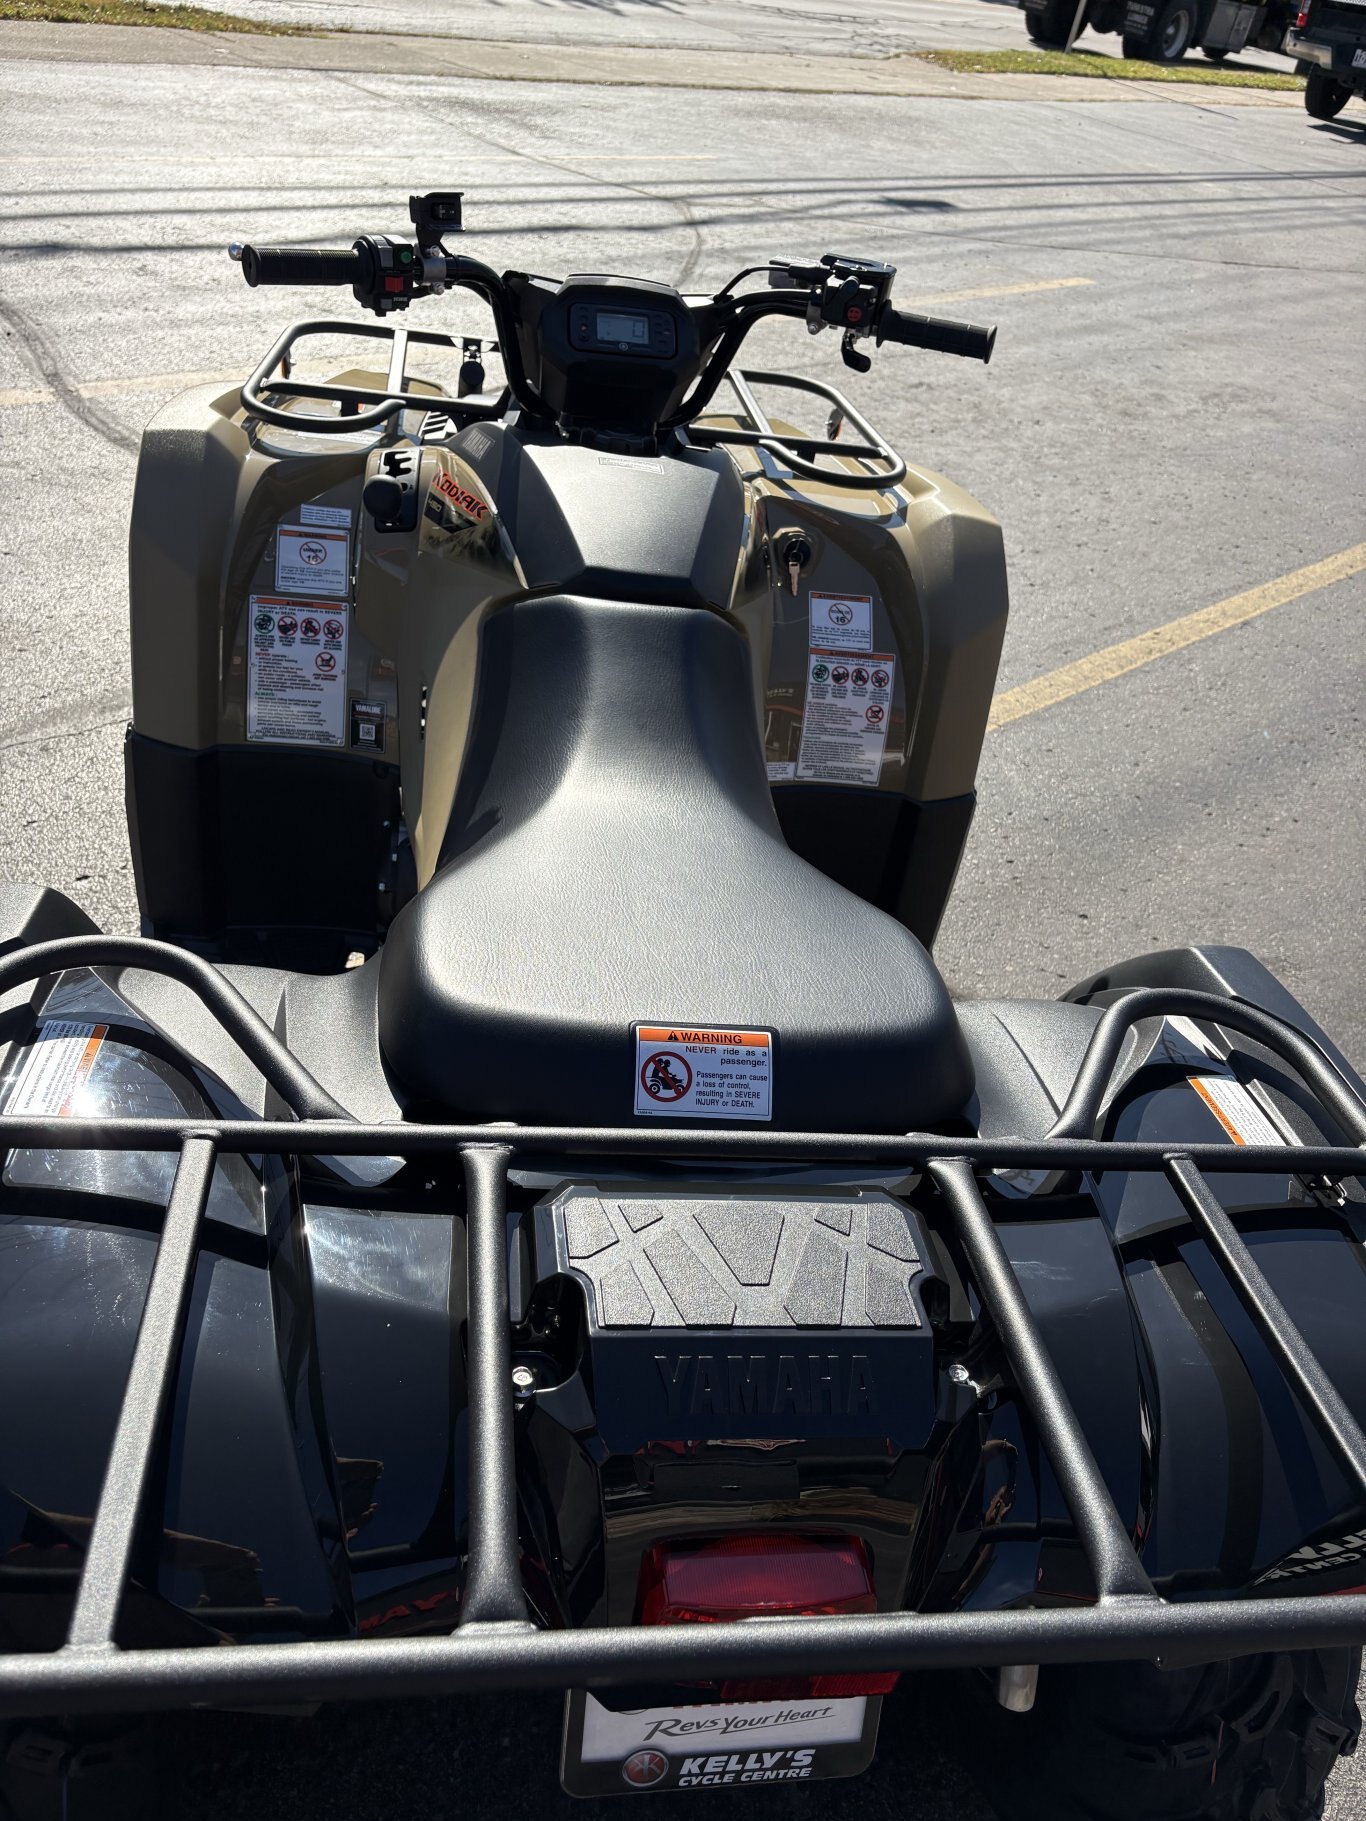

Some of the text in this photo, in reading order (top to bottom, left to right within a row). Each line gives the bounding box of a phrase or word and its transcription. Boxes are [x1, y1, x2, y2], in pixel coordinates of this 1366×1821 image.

[432, 469, 489, 520] KODIAK
[680, 1031, 743, 1044] WARNING
[685, 1045, 717, 1055] NEVER
[722, 1047, 740, 1056] ride
[745, 1049, 756, 1057] as
[720, 1057, 767, 1068] passenger.
[696, 1070, 768, 1082] Passengers can cause
[702, 1080, 716, 1088] loss
[695, 1090, 761, 1099] resulting in SEVERE
[695, 1099, 719, 1107] INJURY
[731, 1100, 755, 1108] DEATH.
[653, 1355, 872, 1416] YAMAHA
[643, 1707, 833, 1742] Revs Your Heart
[679, 1749, 816, 1776] KELLY'S
[678, 1767, 813, 1787] CYCLE CENTRE
